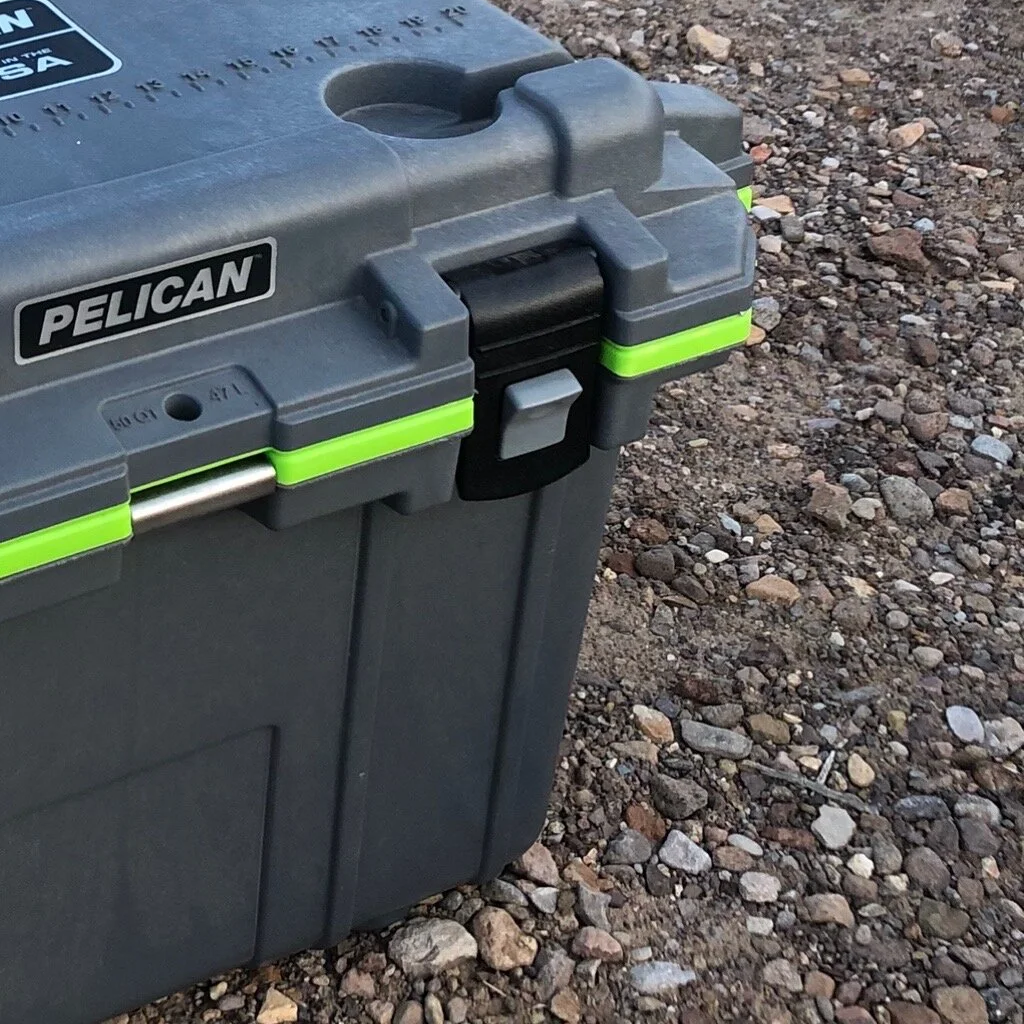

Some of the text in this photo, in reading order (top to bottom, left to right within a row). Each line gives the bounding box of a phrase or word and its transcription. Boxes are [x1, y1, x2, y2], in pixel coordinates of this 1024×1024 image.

[1, 54, 19, 65] IN
[20, 47, 54, 61] THE
[41, 102, 73, 117] 11
[89, 89, 121, 105] 12
[314, 34, 340, 49] 17
[38, 255, 255, 346] PELICAN
